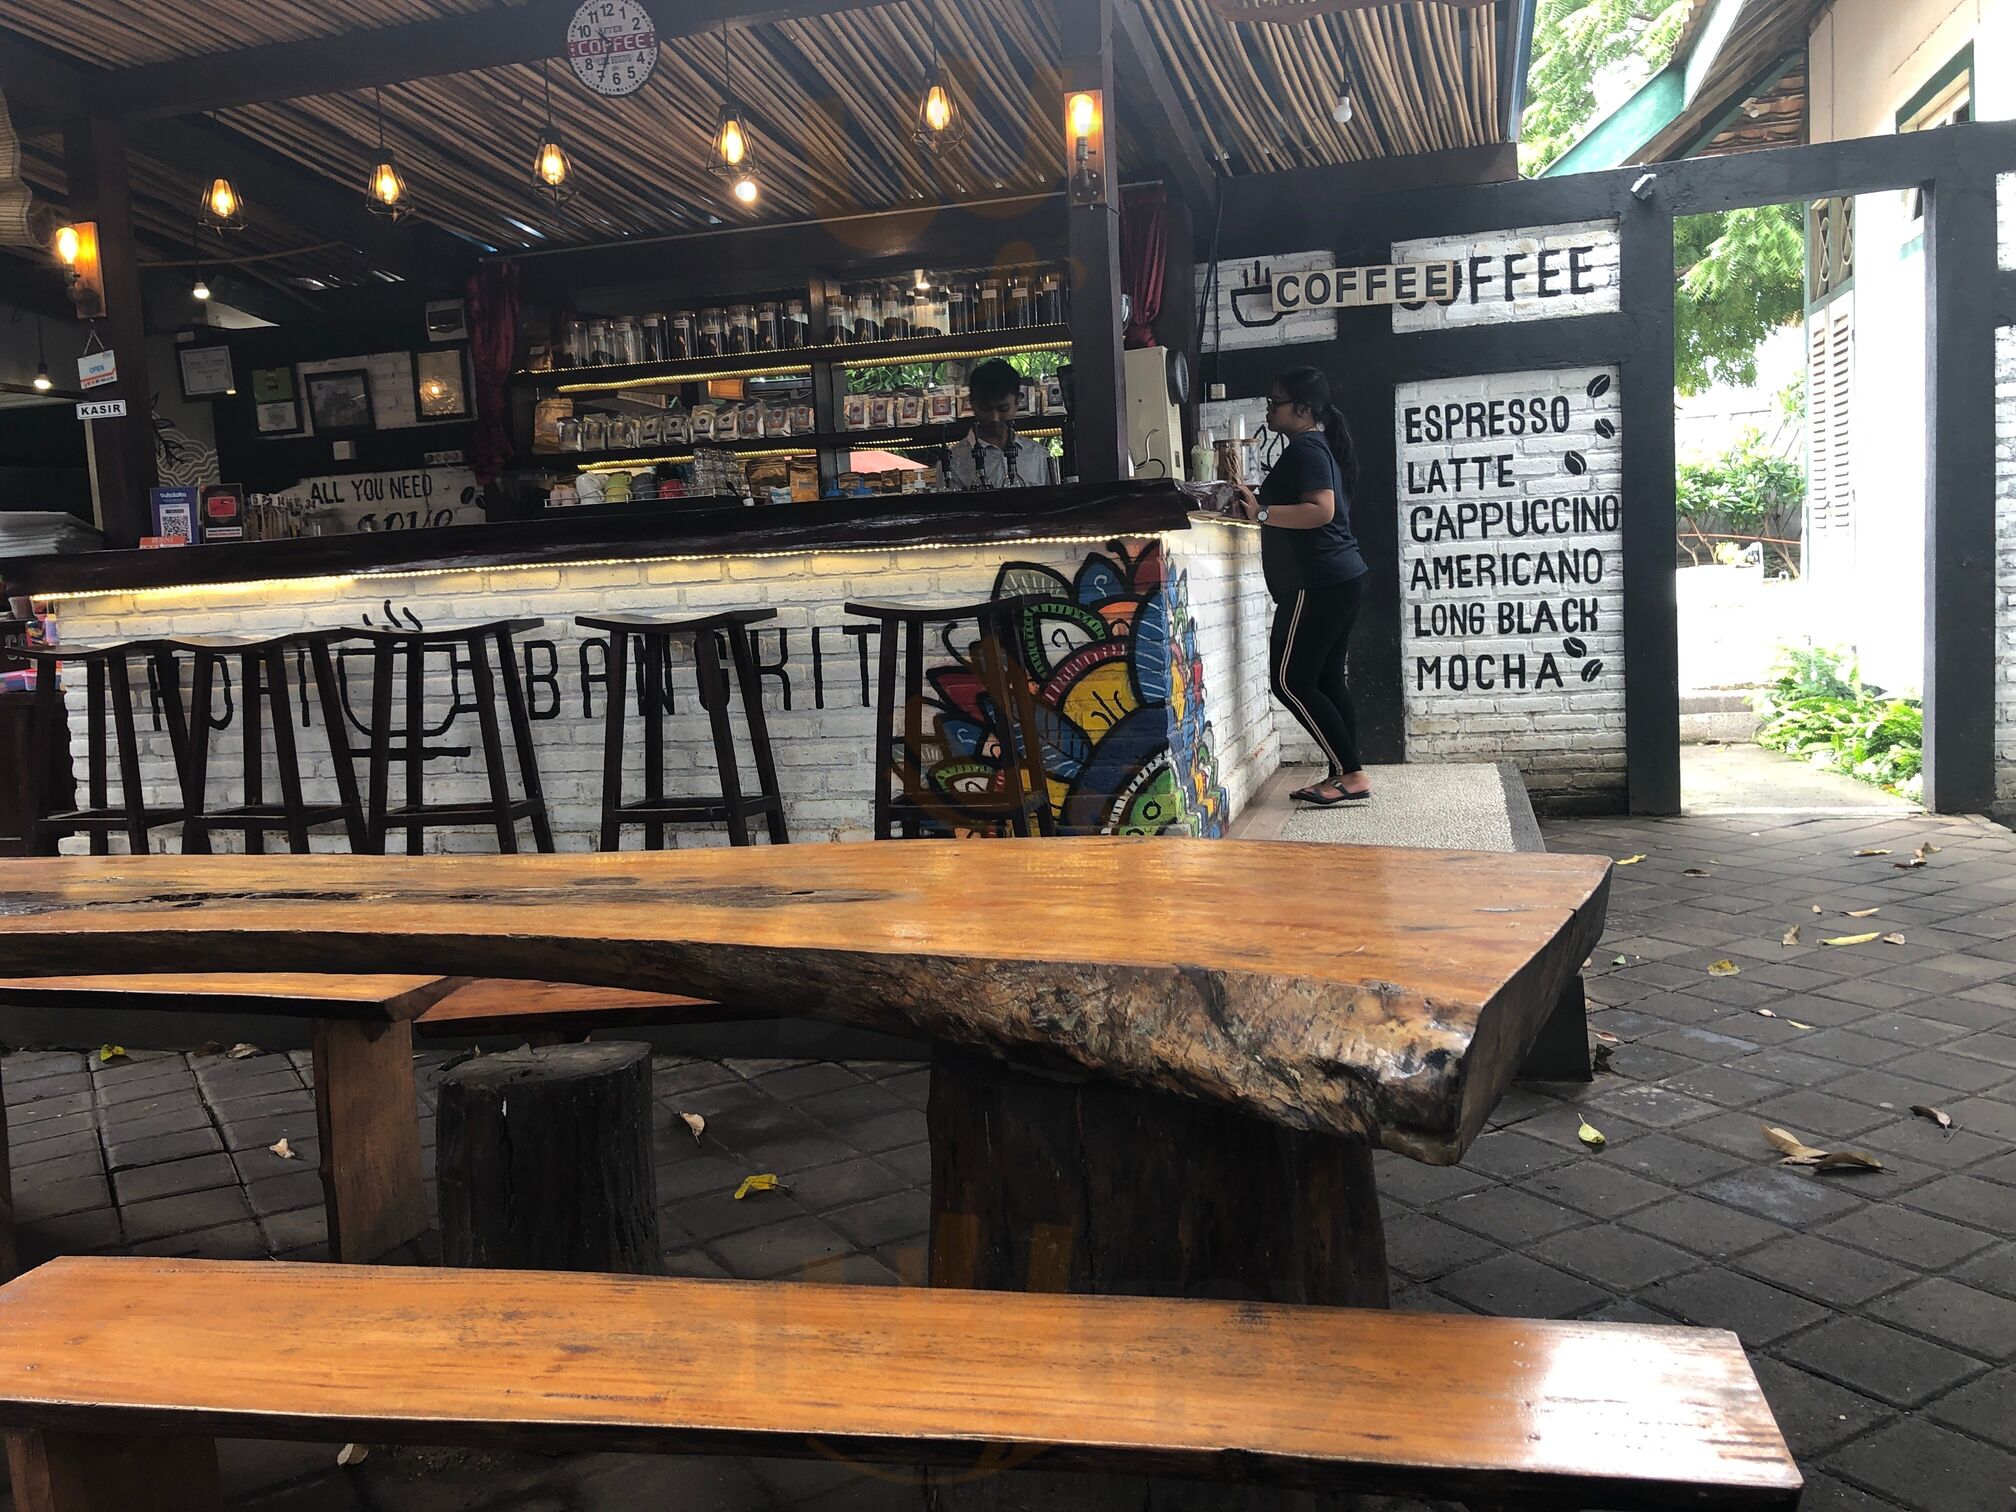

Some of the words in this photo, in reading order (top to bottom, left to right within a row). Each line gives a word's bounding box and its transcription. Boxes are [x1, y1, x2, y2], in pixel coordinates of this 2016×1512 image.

[587, 11, 600, 24] 11
[600, 3, 614, 17] 12
[619, 6, 626, 20] 1
[577, 25, 592, 39] 10
[631, 17, 641, 31] 2
[577, 34, 648, 56] COFFEE
[585, 58, 594, 71] 8
[636, 51, 646, 64] 4
[596, 70, 606, 83] 7
[613, 72, 621, 86] 6
[627, 66, 636, 80] 5
[1276, 263, 1450, 308] COFFEE
[1399, 245, 1596, 310] FFEE
[80, 404, 121, 416] KASIR
[1404, 396, 1570, 444] ESPRESSO
[1407, 453, 1515, 494] LATTE
[311, 481, 345, 505] ALL
[351, 478, 384, 502] YOU
[389, 473, 432, 500] NEED
[1410, 494, 1619, 543] CAPPUCCINO
[1410, 547, 1603, 591] AMERICANO
[1414, 602, 1485, 637] LONG
[1498, 597, 1598, 634] BLACK
[524, 624, 881, 720] BANGKIT
[1417, 652, 1564, 691] MOCHA
